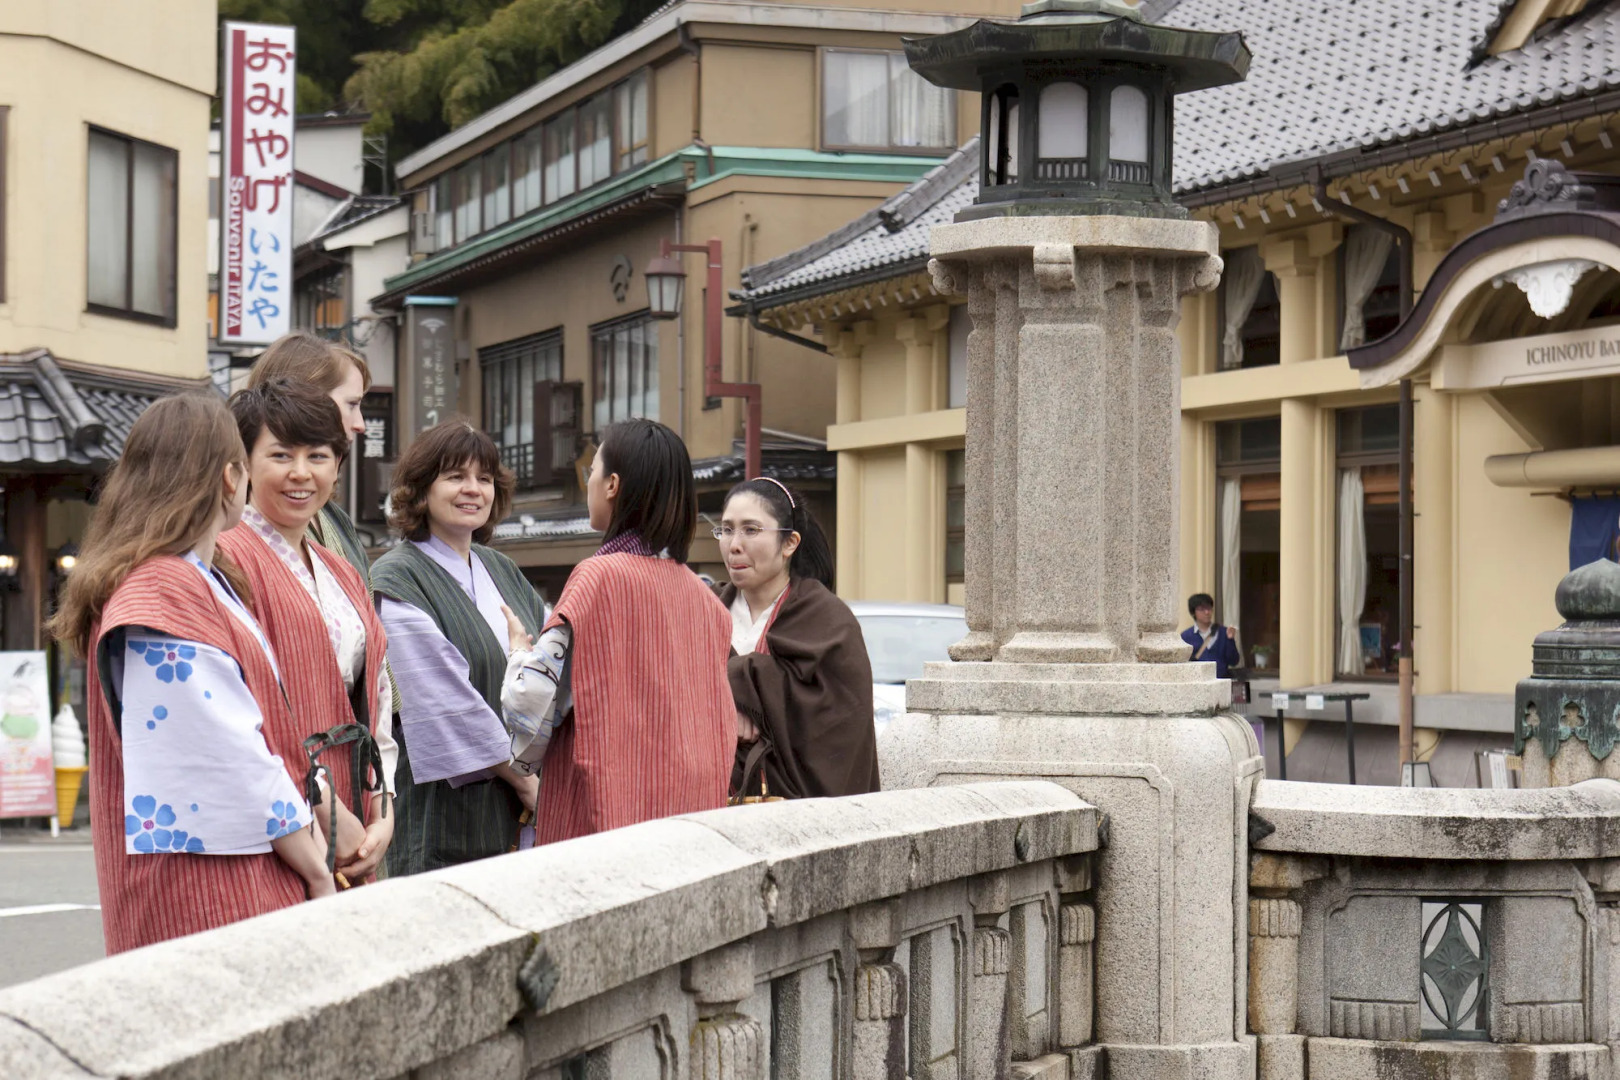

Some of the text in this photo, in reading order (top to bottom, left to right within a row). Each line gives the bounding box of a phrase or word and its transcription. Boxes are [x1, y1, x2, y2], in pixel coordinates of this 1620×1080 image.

[227, 175, 246, 328] Souvenir ITAYA
[1526, 340, 1596, 366] ICHINOYU
